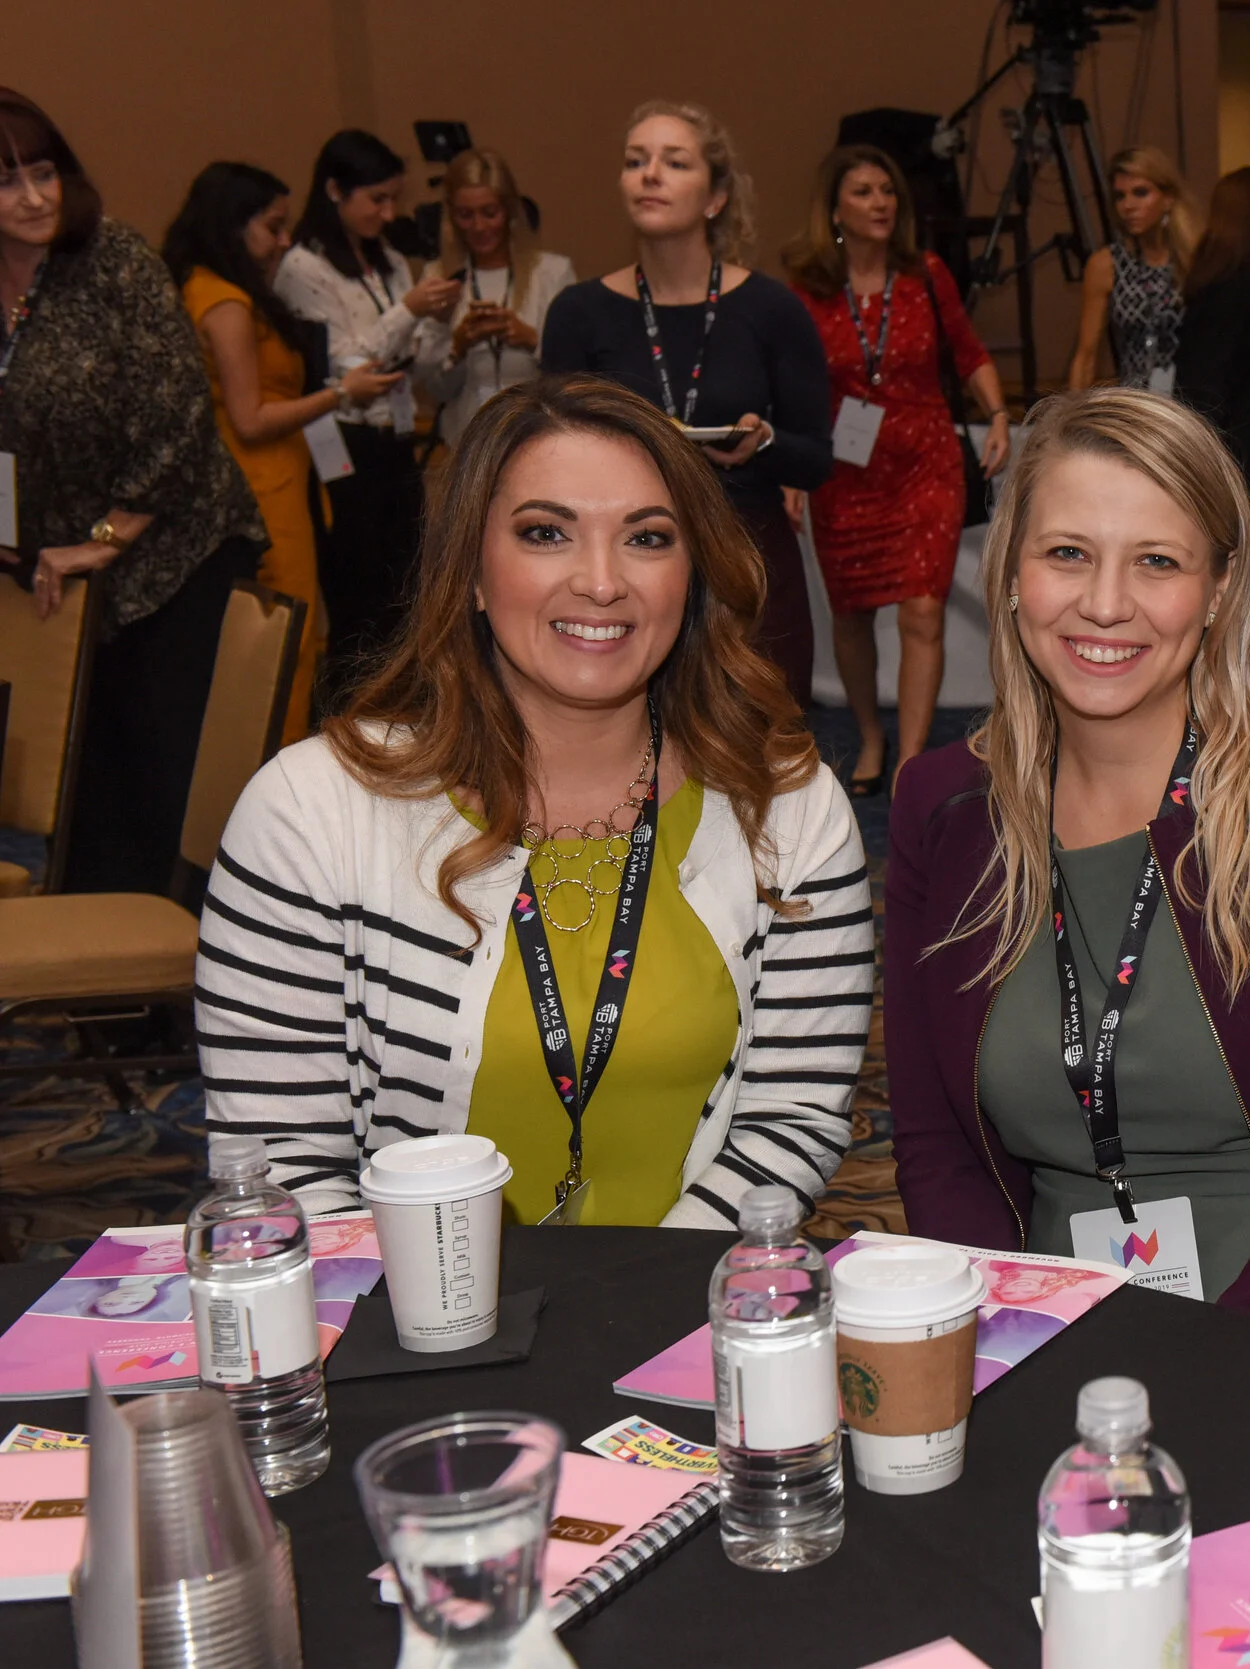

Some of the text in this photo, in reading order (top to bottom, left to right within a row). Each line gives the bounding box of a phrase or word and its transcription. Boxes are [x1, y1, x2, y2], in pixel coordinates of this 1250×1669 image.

[639, 846, 649, 872] PORT
[619, 847, 641, 925] TAMPA BAY
[1130, 855, 1156, 930] AMPA BAY
[535, 946, 562, 1026] TAMPA BAY
[539, 1002, 551, 1029] PORT
[1064, 963, 1082, 1042] TAMPA BAY
[584, 1026, 604, 1075] TAMPA
[602, 1028, 613, 1054] PORT
[1105, 1034, 1115, 1062] PORT
[1094, 1033, 1108, 1116] TAMPA BAY
[1133, 1271, 1189, 1286] CONFERENCE
[442, 1300, 448, 1310] WE
[634, 1440, 717, 1469] VERTHELESS
